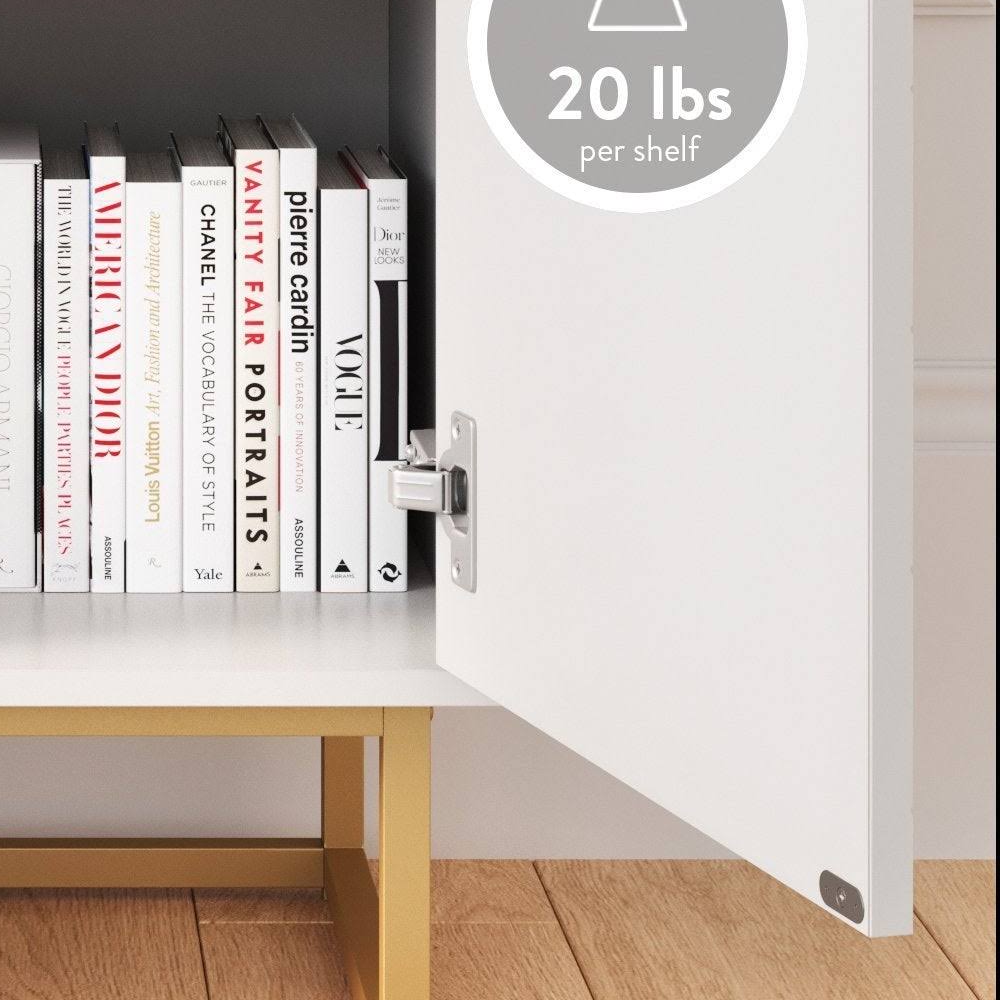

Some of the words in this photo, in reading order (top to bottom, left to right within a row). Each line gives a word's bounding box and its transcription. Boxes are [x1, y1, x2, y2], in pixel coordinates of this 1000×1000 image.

[57, 184, 72, 216] THE
[244, 160, 264, 265] VANITY
[283, 191, 314, 266] pierre
[57, 220, 72, 276] WORLD
[144, 210, 161, 296] Architecture
[200, 203, 216, 287] CHANEL
[373, 226, 406, 241] Dior
[377, 247, 401, 256] NEW
[57, 280, 72, 295] IN
[94, 181, 122, 360] AMERICAN
[57, 300, 72, 351] VOGUE
[144, 298, 161, 326] and
[201, 292, 215, 325] THE
[244, 281, 265, 346] FAIR
[289, 275, 315, 353] cardin
[57, 355, 72, 416] PEOPLE
[144, 329, 161, 385] Fashion
[334, 333, 363, 431] VOGUE
[94, 373, 122, 458] DIOR
[201, 330, 215, 447] VOCABULARY
[294, 376, 304, 410] YEARS
[294, 412, 304, 425] OF
[57, 422, 72, 488] PARTIES
[144, 420, 161, 477] Vuitton
[201, 452, 215, 475] OF
[244, 364, 269, 543] PORTRAITS
[294, 428, 304, 493] INNOVATION
[57, 494, 72, 555] PLACES
[144, 479, 161, 523] Louis
[201, 481, 215, 532] STYLE
[104, 535, 112, 581] ASSOULINE
[194, 568, 223, 580] Yale
[294, 518, 304, 578] ASSOULINE
